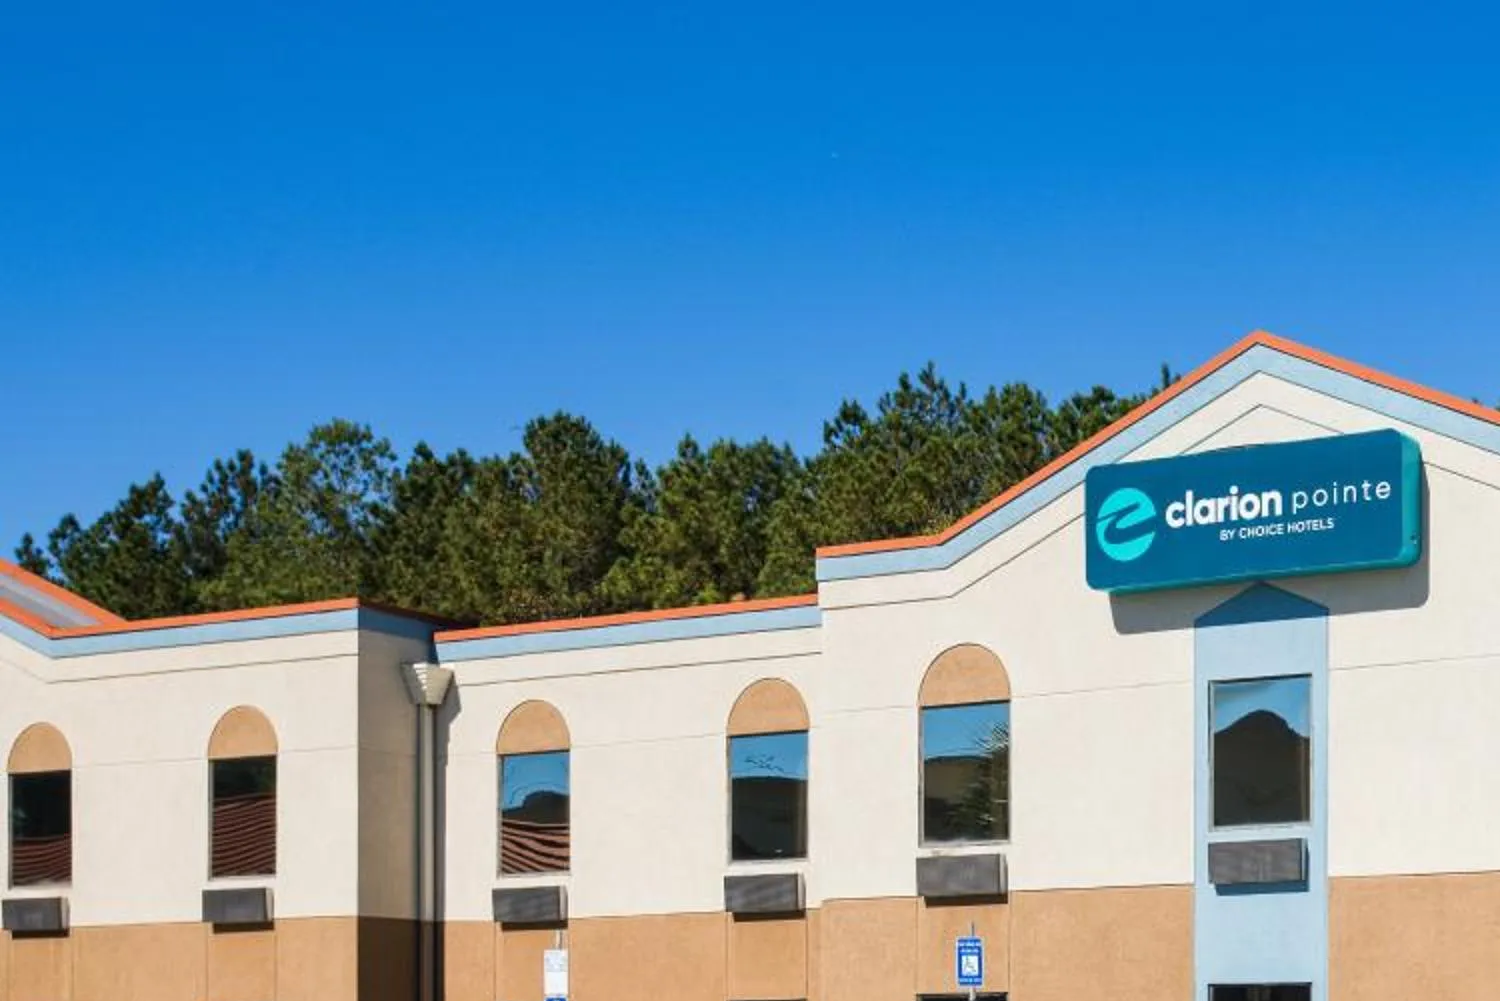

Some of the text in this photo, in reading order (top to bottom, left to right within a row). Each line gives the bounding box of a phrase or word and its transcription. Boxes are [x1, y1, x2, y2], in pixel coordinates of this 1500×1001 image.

[1165, 479, 1392, 529] clarion pointe
[1219, 517, 1335, 541] BY CHOICE HOTELS
